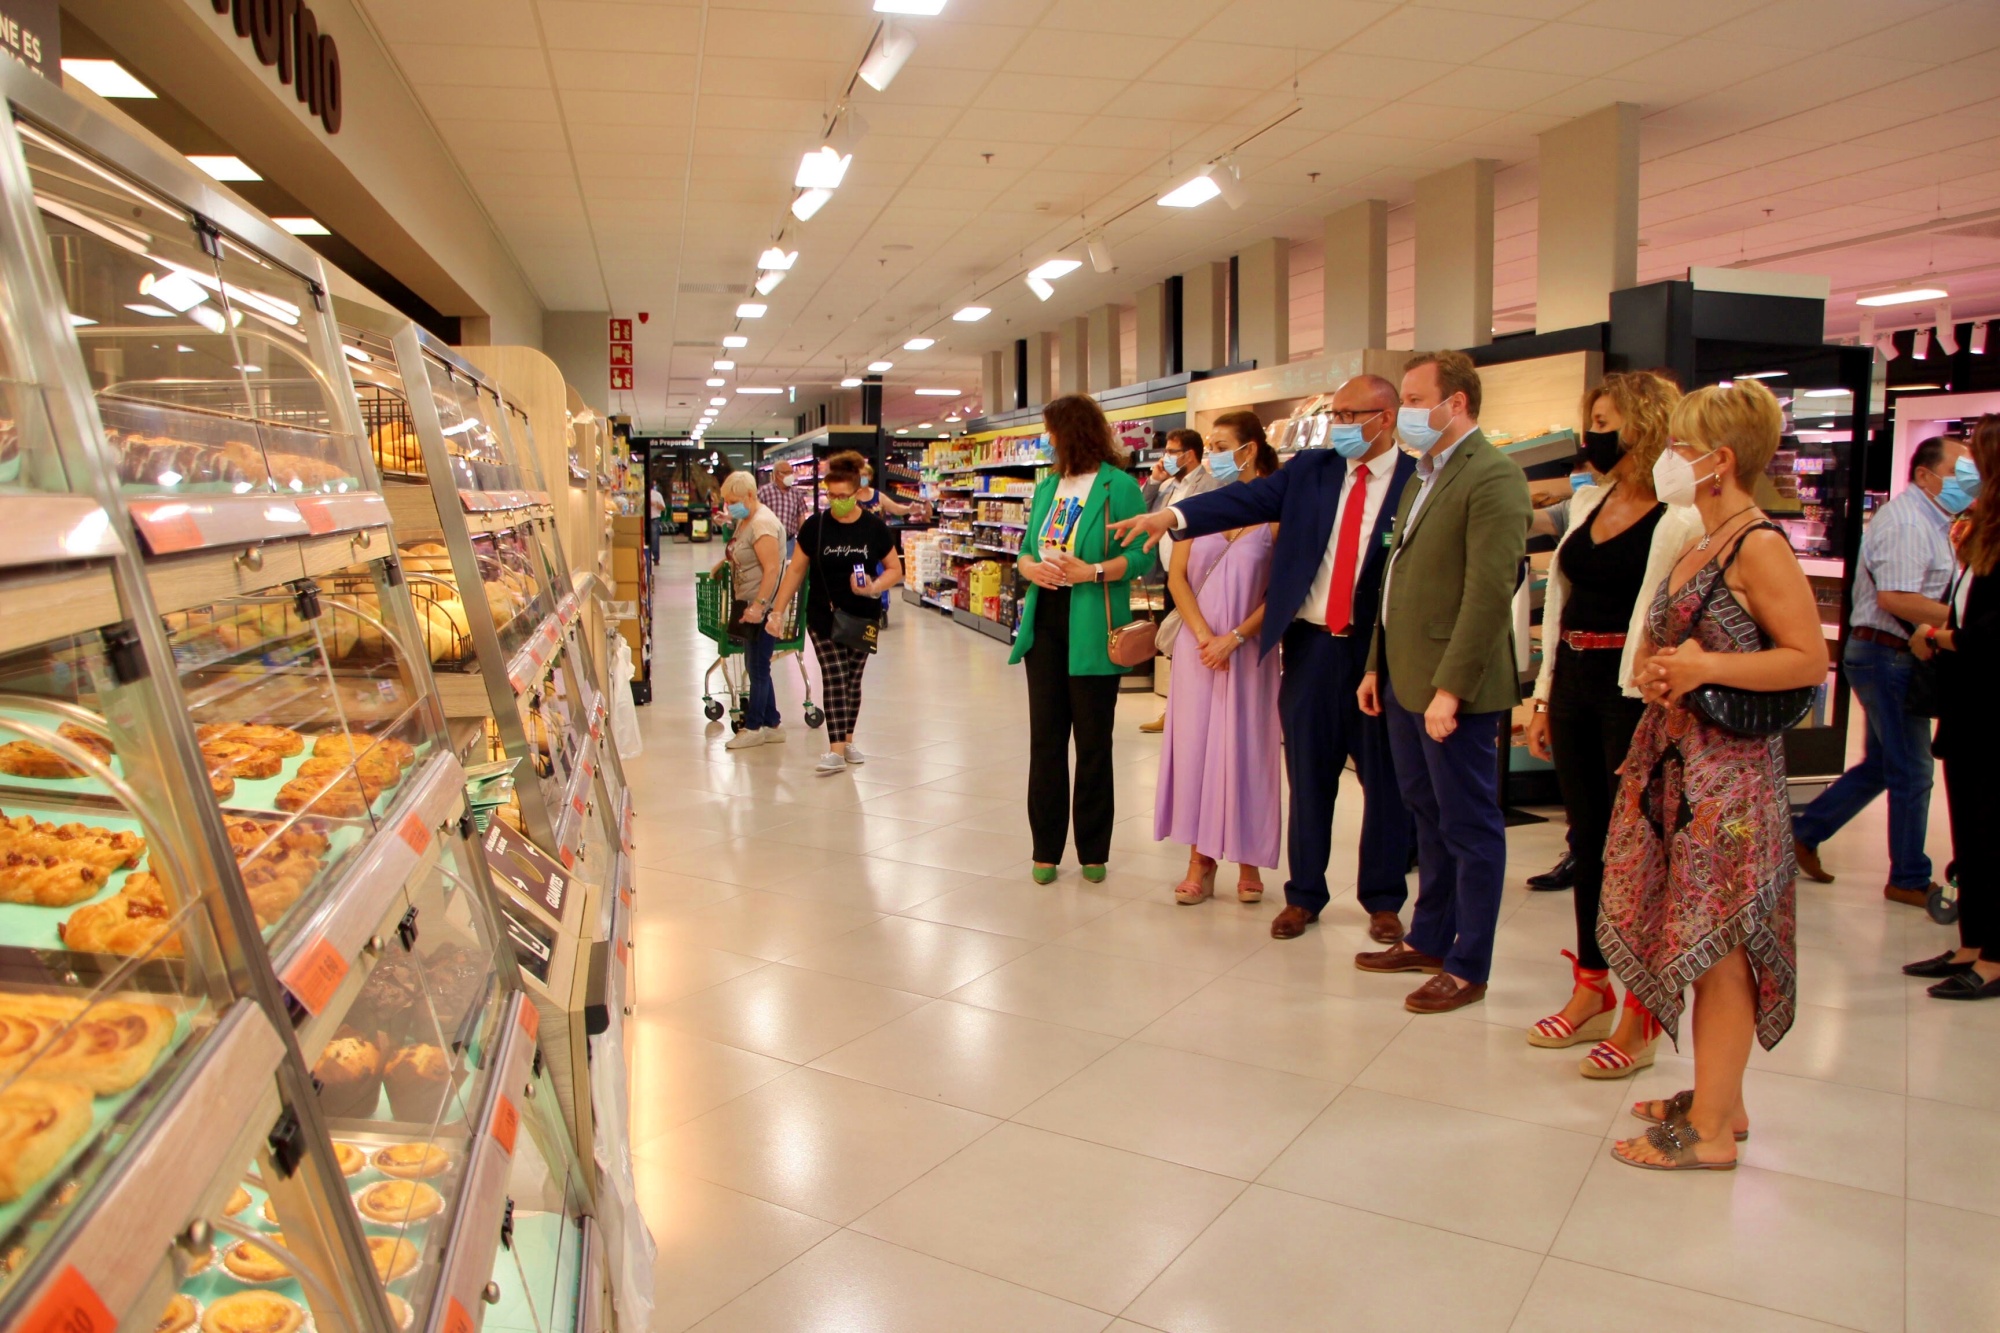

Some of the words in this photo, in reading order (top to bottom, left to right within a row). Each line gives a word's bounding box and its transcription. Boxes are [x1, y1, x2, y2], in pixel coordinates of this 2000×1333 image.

[22, 29, 42, 64] ES
[211, 0, 342, 135] orno
[546, 873, 564, 909] GUANTES
